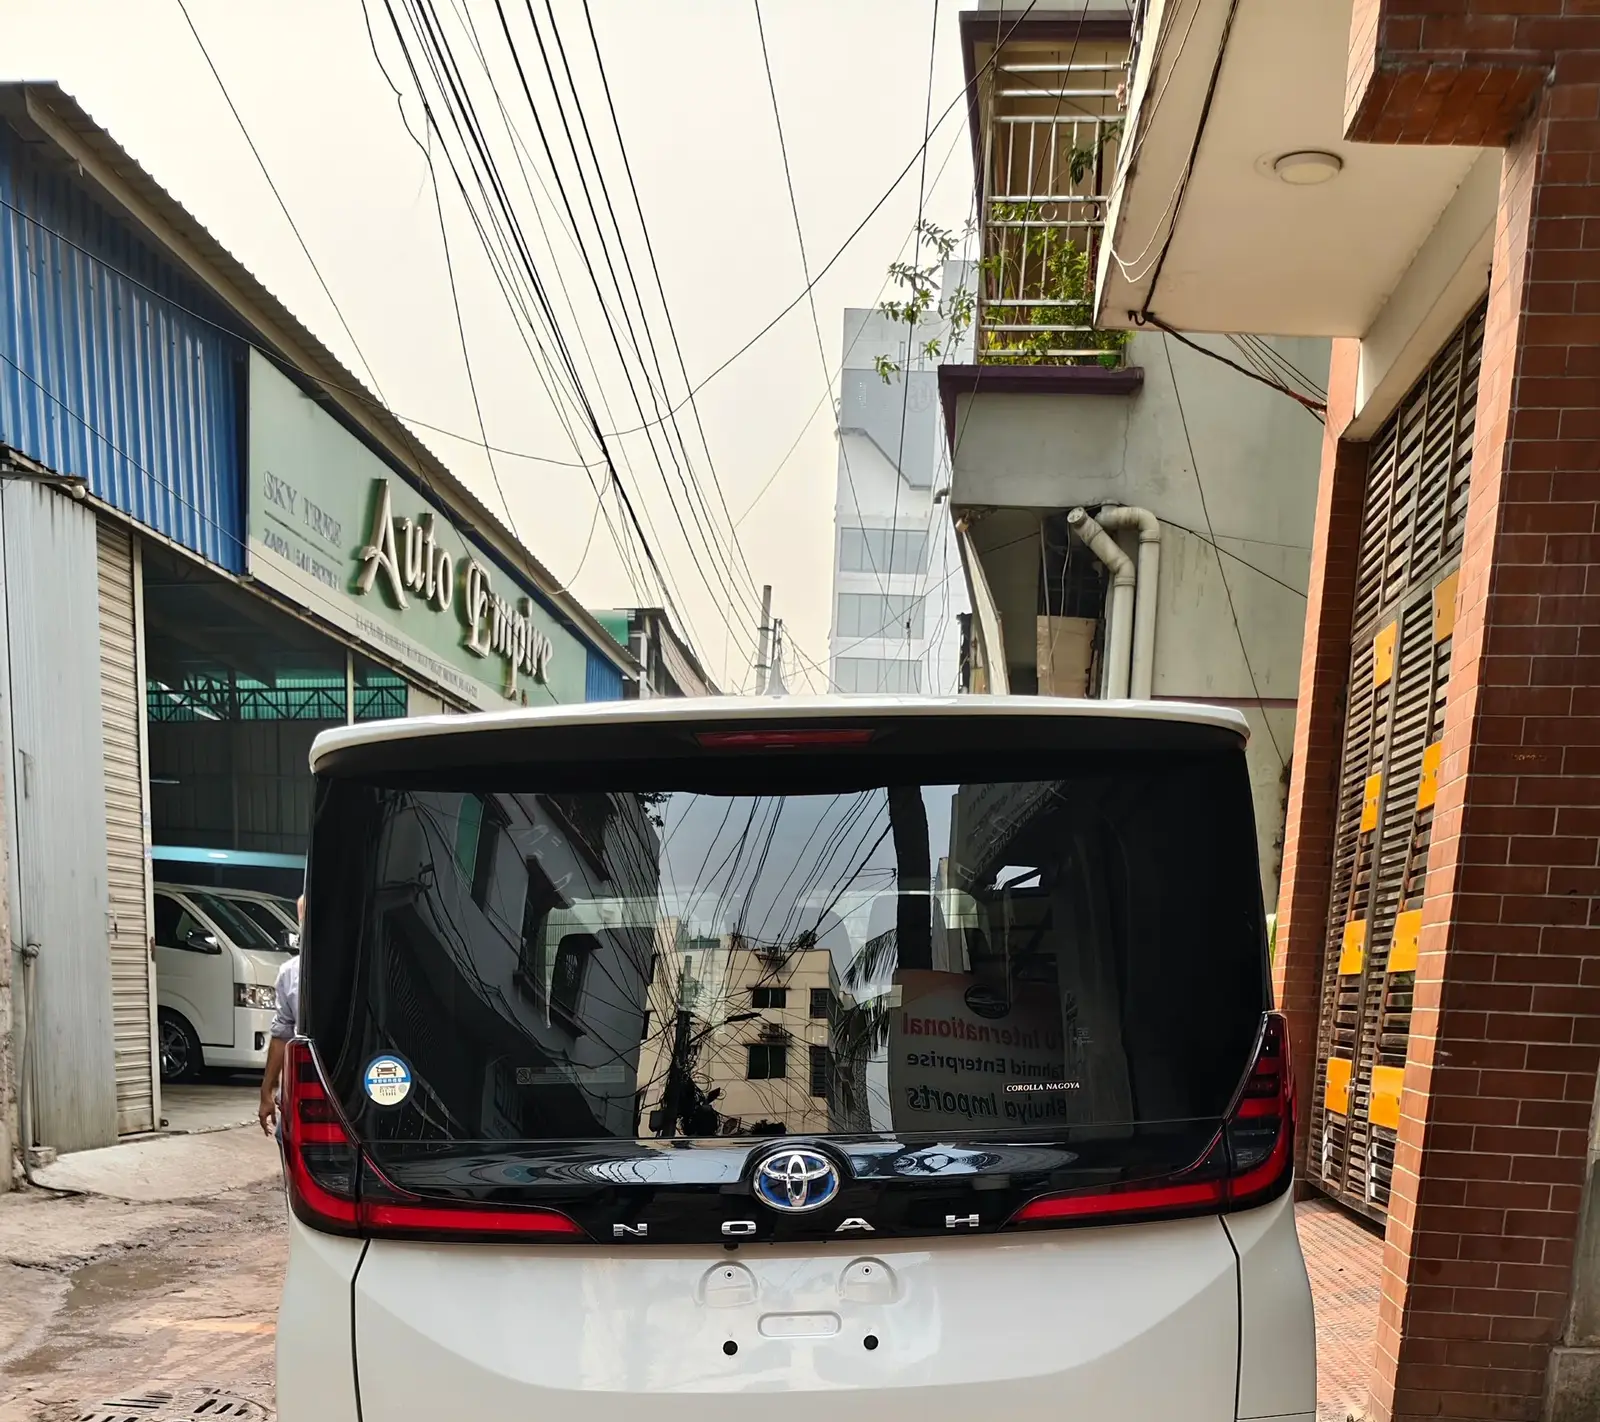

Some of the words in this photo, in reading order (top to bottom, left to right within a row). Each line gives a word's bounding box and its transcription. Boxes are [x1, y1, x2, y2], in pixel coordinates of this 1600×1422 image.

[264, 470, 297, 516] SKY
[357, 478, 453, 612] Auto
[464, 558, 553, 700] Empire
[1005, 1083, 1044, 1092] COROLLA
[1045, 1081, 1080, 1091] NAGOYA
[613, 1213, 980, 1237] NOAH
